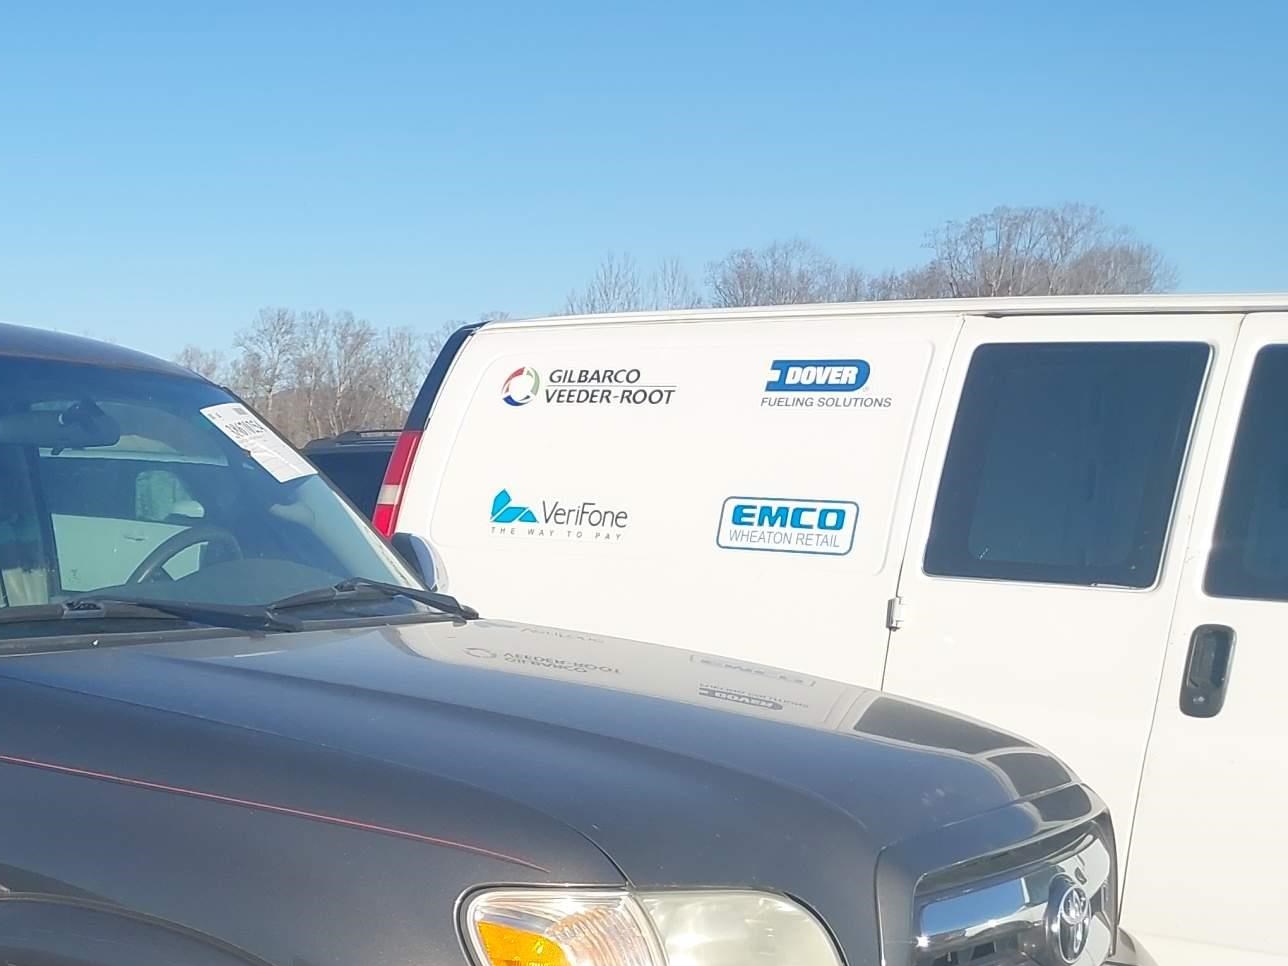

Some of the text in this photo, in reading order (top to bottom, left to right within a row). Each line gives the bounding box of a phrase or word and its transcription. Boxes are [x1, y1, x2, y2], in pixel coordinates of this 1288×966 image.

[549, 368, 640, 384] GILBARCO
[784, 366, 859, 385] DOVER
[545, 389, 676, 405] VEEDER-ROOT
[760, 397, 892, 408] FUELING SOLUTIONS
[542, 500, 628, 528] VeriFone
[731, 504, 846, 531] EMCO
[490, 526, 622, 541] THE WAY TO PAY
[729, 529, 841, 548] WHEATON RETAIL
